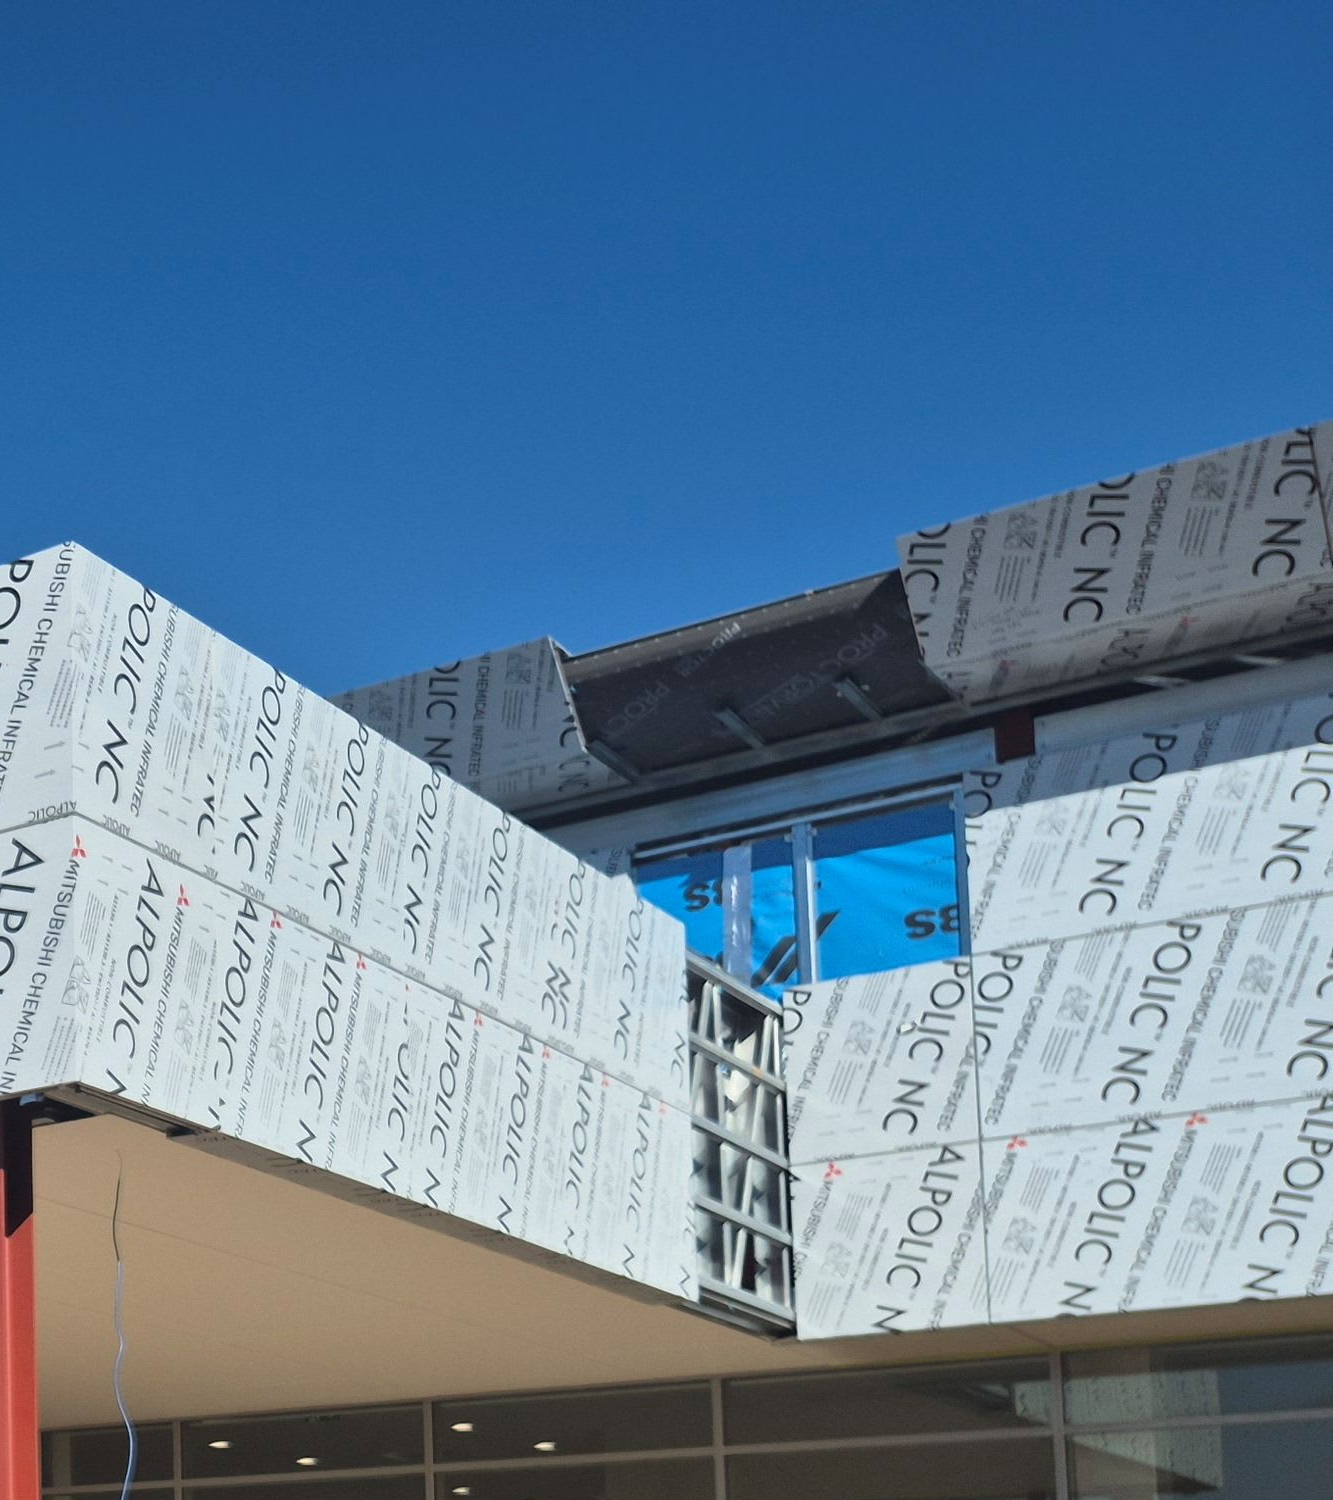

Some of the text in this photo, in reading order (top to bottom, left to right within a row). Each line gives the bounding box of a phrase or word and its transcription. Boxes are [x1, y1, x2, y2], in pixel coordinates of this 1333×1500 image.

[1063, 567, 1112, 623] NC
[1251, 517, 1307, 577] NC
[10, 616, 53, 721] CHEMICAL
[95, 588, 156, 804] POLIC NC
[130, 661, 167, 818] CHEMICAL INFRATEC
[234, 669, 286, 872] POLIC NC
[324, 722, 369, 916] POLIC NC
[1078, 732, 1177, 915] POLIC NC
[403, 884, 424, 954] NC
[1260, 823, 1317, 883] NC
[5, 859, 81, 1069] MITSUBISHI CHEMICAL
[113, 858, 163, 1058] ALPOLIC
[145, 906, 188, 1081] MITSUBISHI CHEMICAL
[218, 900, 259, 1075] ALPOLIC
[241, 932, 278, 1092] MITSUBISHI CHEMICAL
[305, 941, 345, 1110] ALPOLIC
[344, 972, 362, 1057] MITSUBISHI
[474, 924, 494, 991] NC
[614, 1001, 631, 1060] NC
[1101, 920, 1202, 1105] POLIC NC
[431, 1001, 464, 1158] ALPOLIC
[503, 1033, 534, 1185] ALPOLIC
[883, 959, 970, 1135] POLIC NC
[1287, 1018, 1333, 1080] NC
[566, 1063, 593, 1209] ALPOLIC
[627, 1091, 652, 1232] ALPOLIC
[1075, 1119, 1160, 1265] ALPOLIC
[886, 1145, 965, 1289] ALPOLIC
